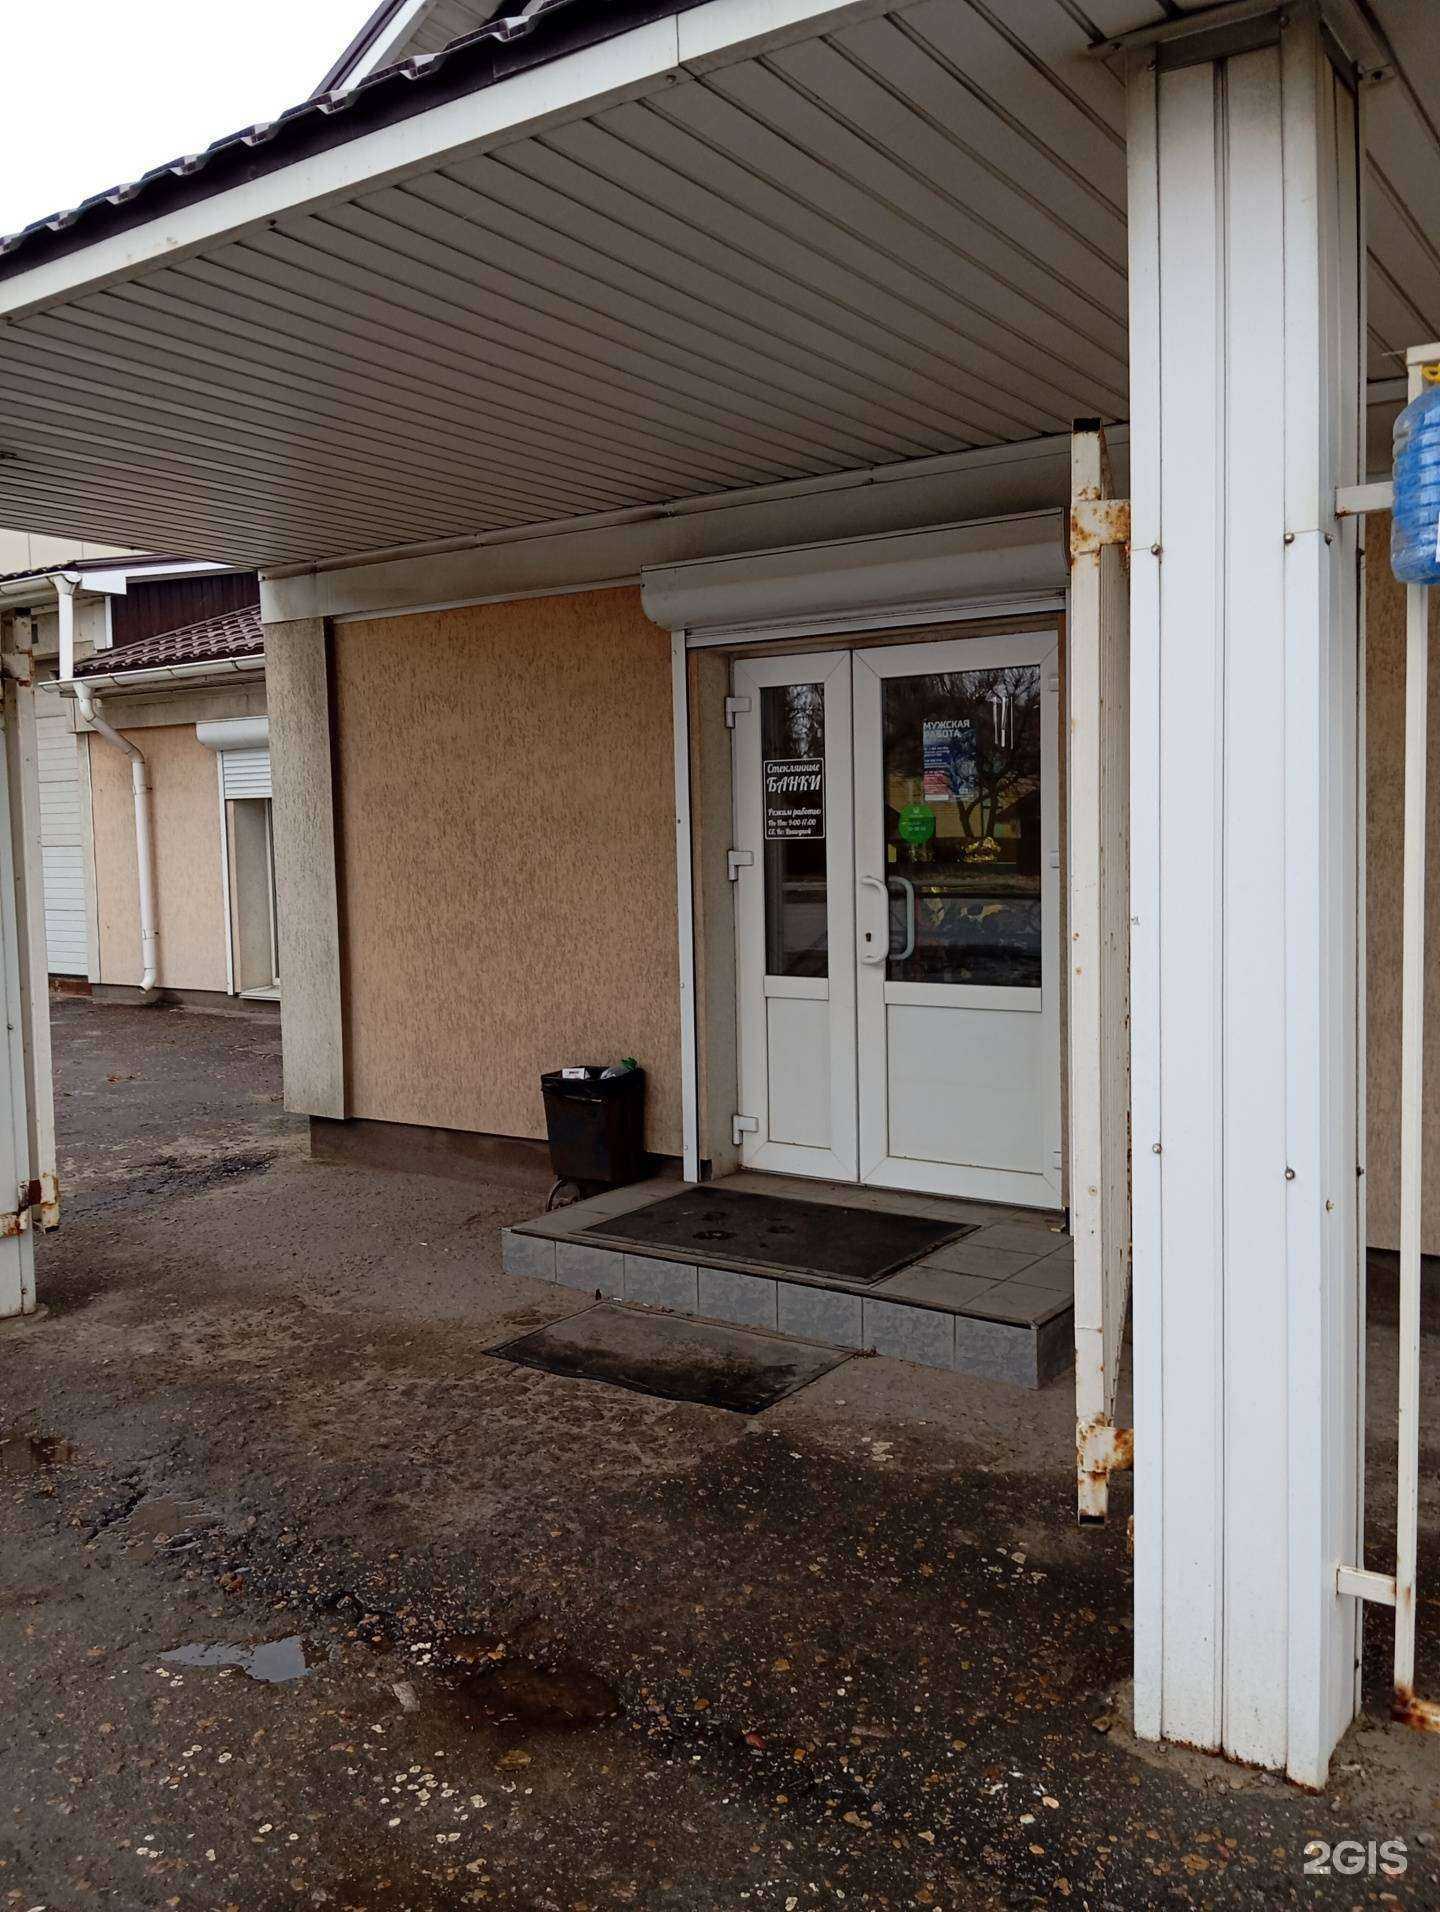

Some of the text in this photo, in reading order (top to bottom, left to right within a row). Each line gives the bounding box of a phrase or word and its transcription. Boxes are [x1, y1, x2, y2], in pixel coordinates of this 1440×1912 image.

[923, 719, 970, 730] МУЖСКАЯ
[923, 728, 962, 738] РАБОТА
[767, 764, 819, 773] Стеклянные
[767, 774, 820, 793] БАНКИ
